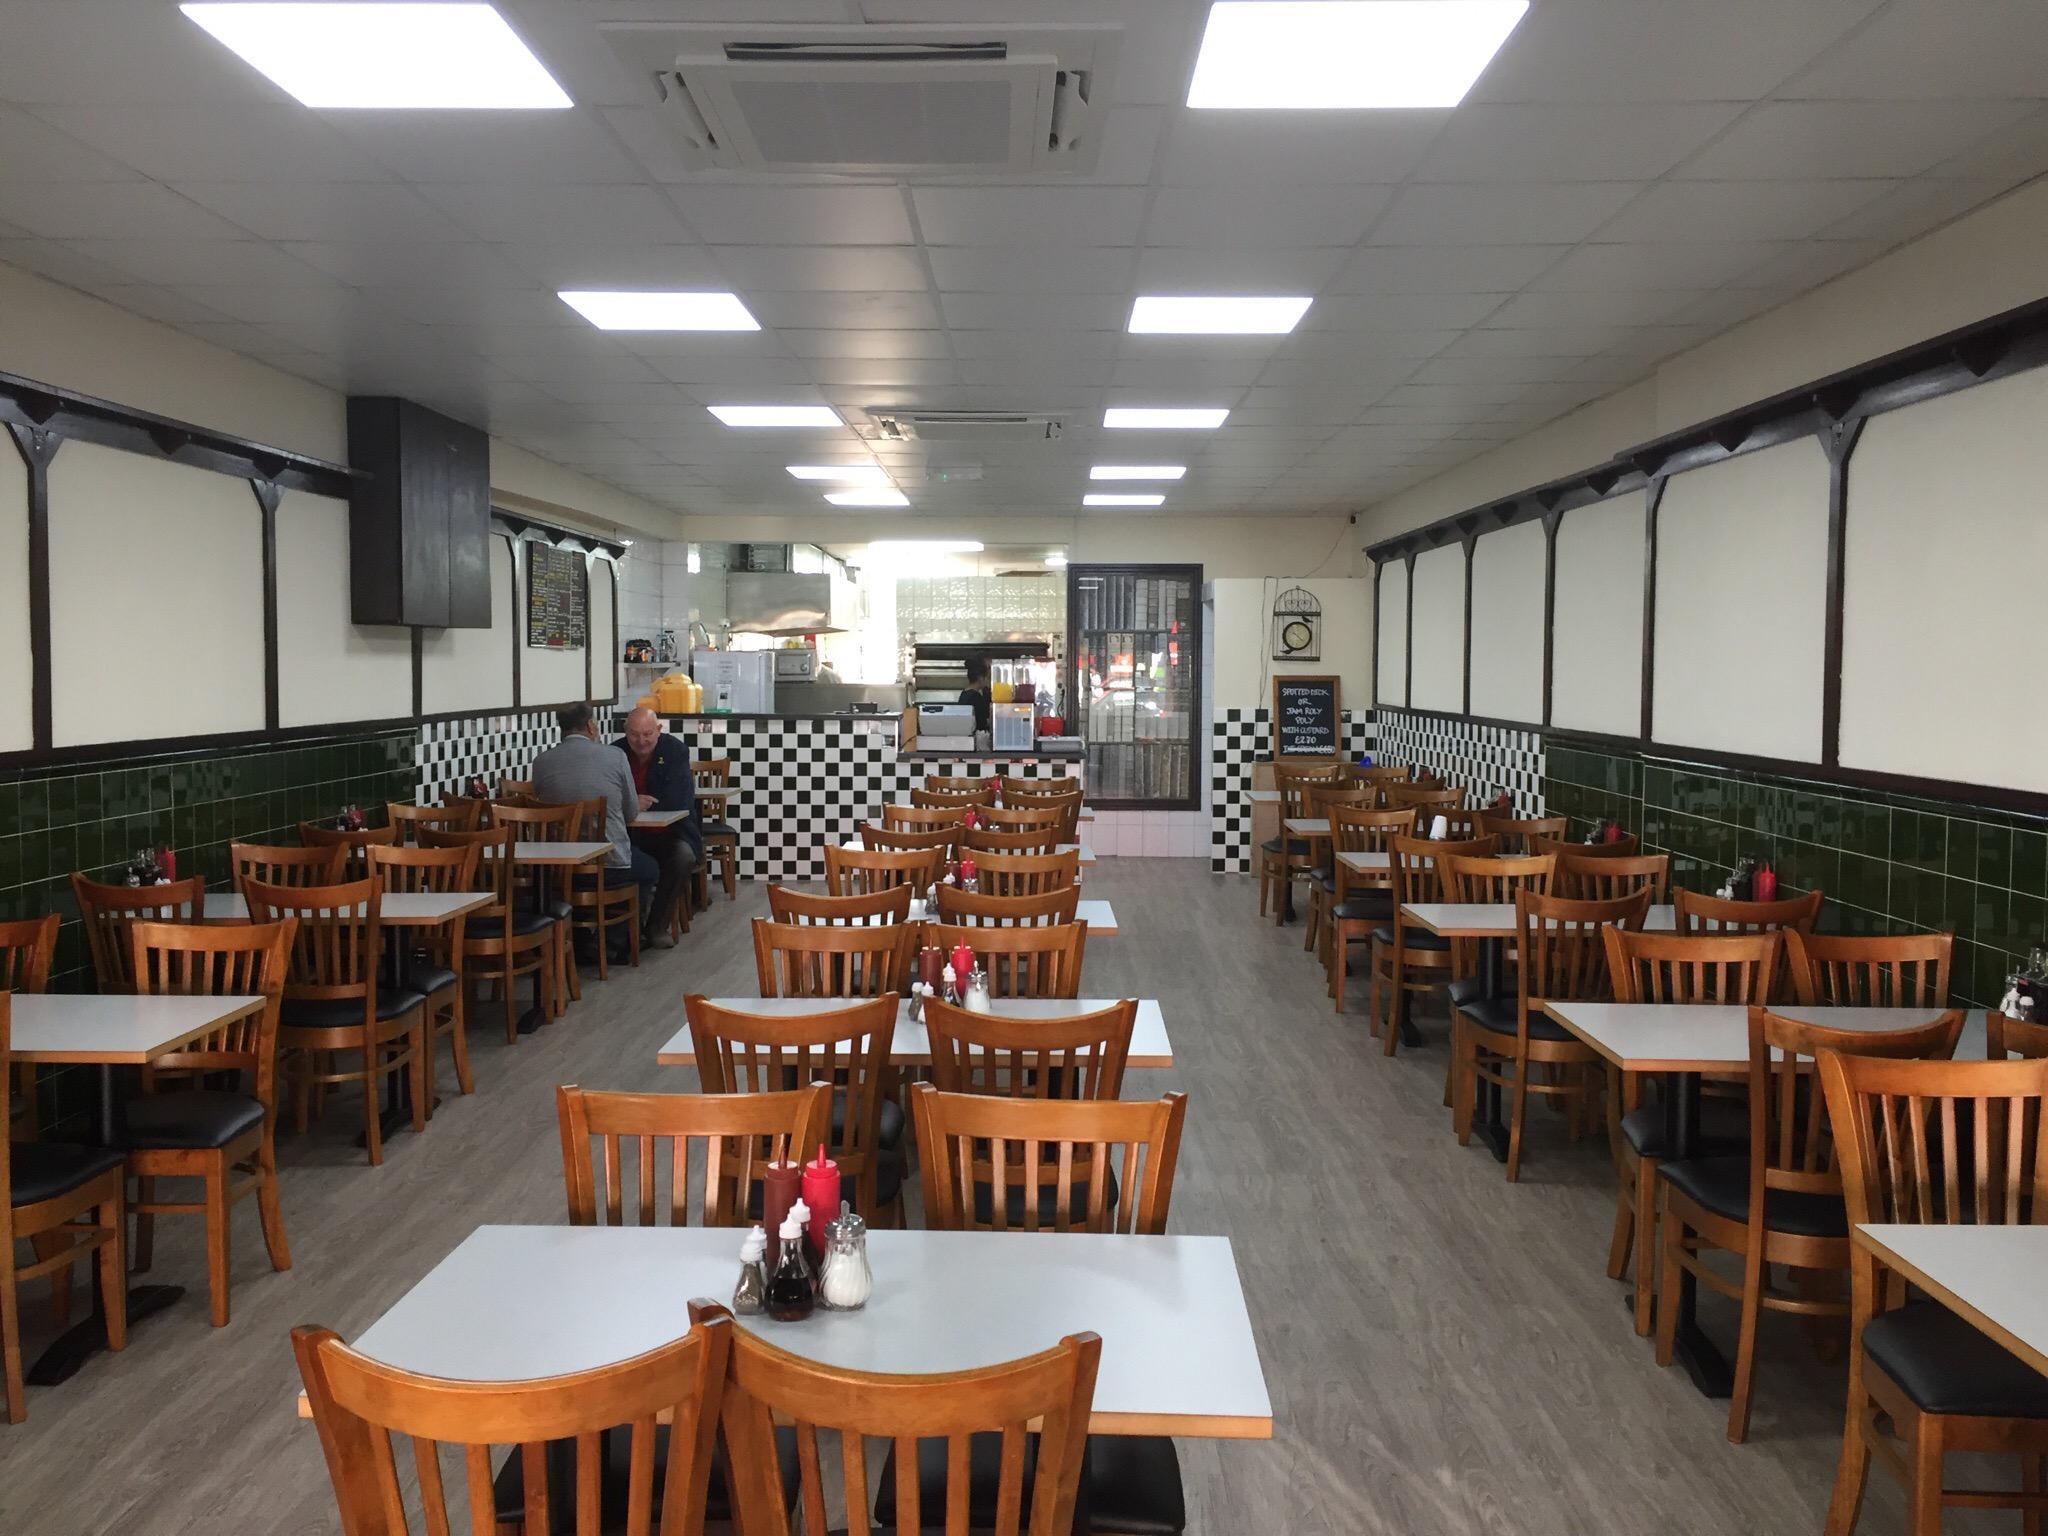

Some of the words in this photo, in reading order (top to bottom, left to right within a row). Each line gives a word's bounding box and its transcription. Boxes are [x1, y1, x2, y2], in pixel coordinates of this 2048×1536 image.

[1282, 688, 1310, 696] SPOTTED
[1311, 688, 1329, 696] DICK
[1286, 707, 1303, 715] JAM
[1305, 707, 1322, 715] ROLY
[1295, 716, 1315, 724] POLY
[1282, 726, 1299, 734] WITH
